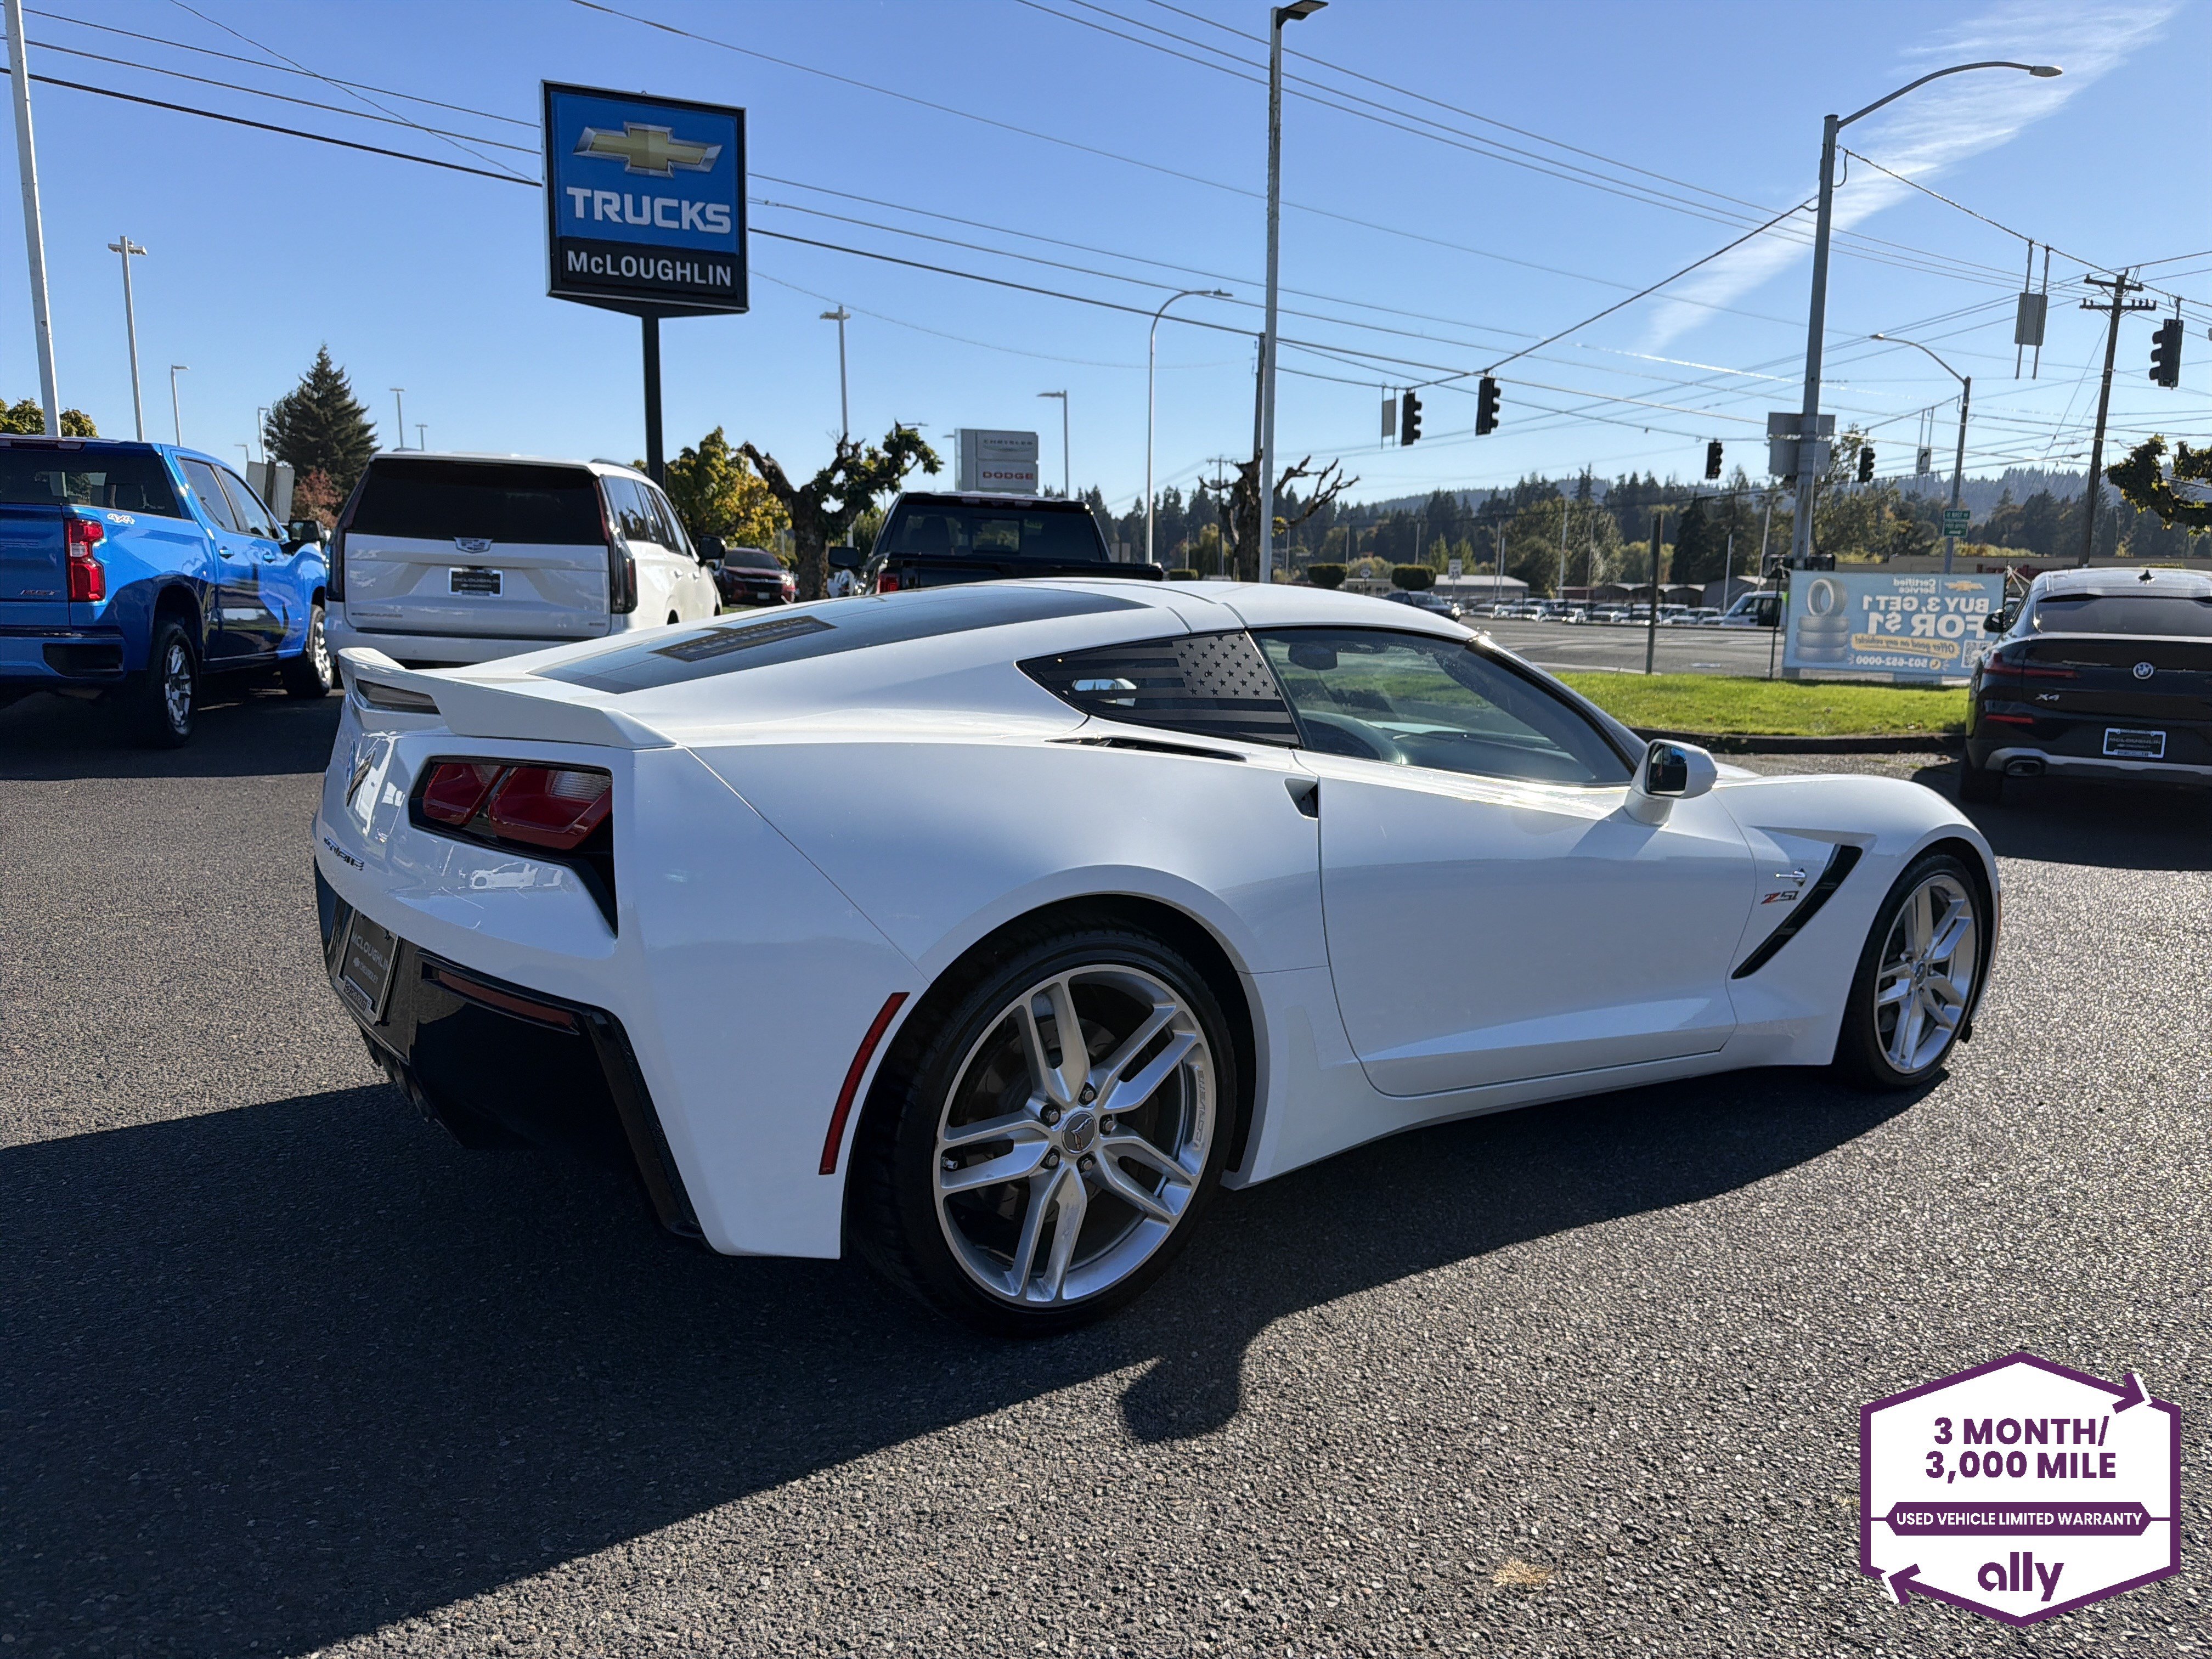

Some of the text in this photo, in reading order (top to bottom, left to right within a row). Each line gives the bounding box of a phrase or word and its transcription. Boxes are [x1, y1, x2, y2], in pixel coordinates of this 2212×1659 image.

[566, 187, 731, 234] TRUCKS
[567, 250, 731, 286] McLOUGHLIN
[983, 471, 1034, 480] DODGE
[1760, 890, 1799, 905] Z51
